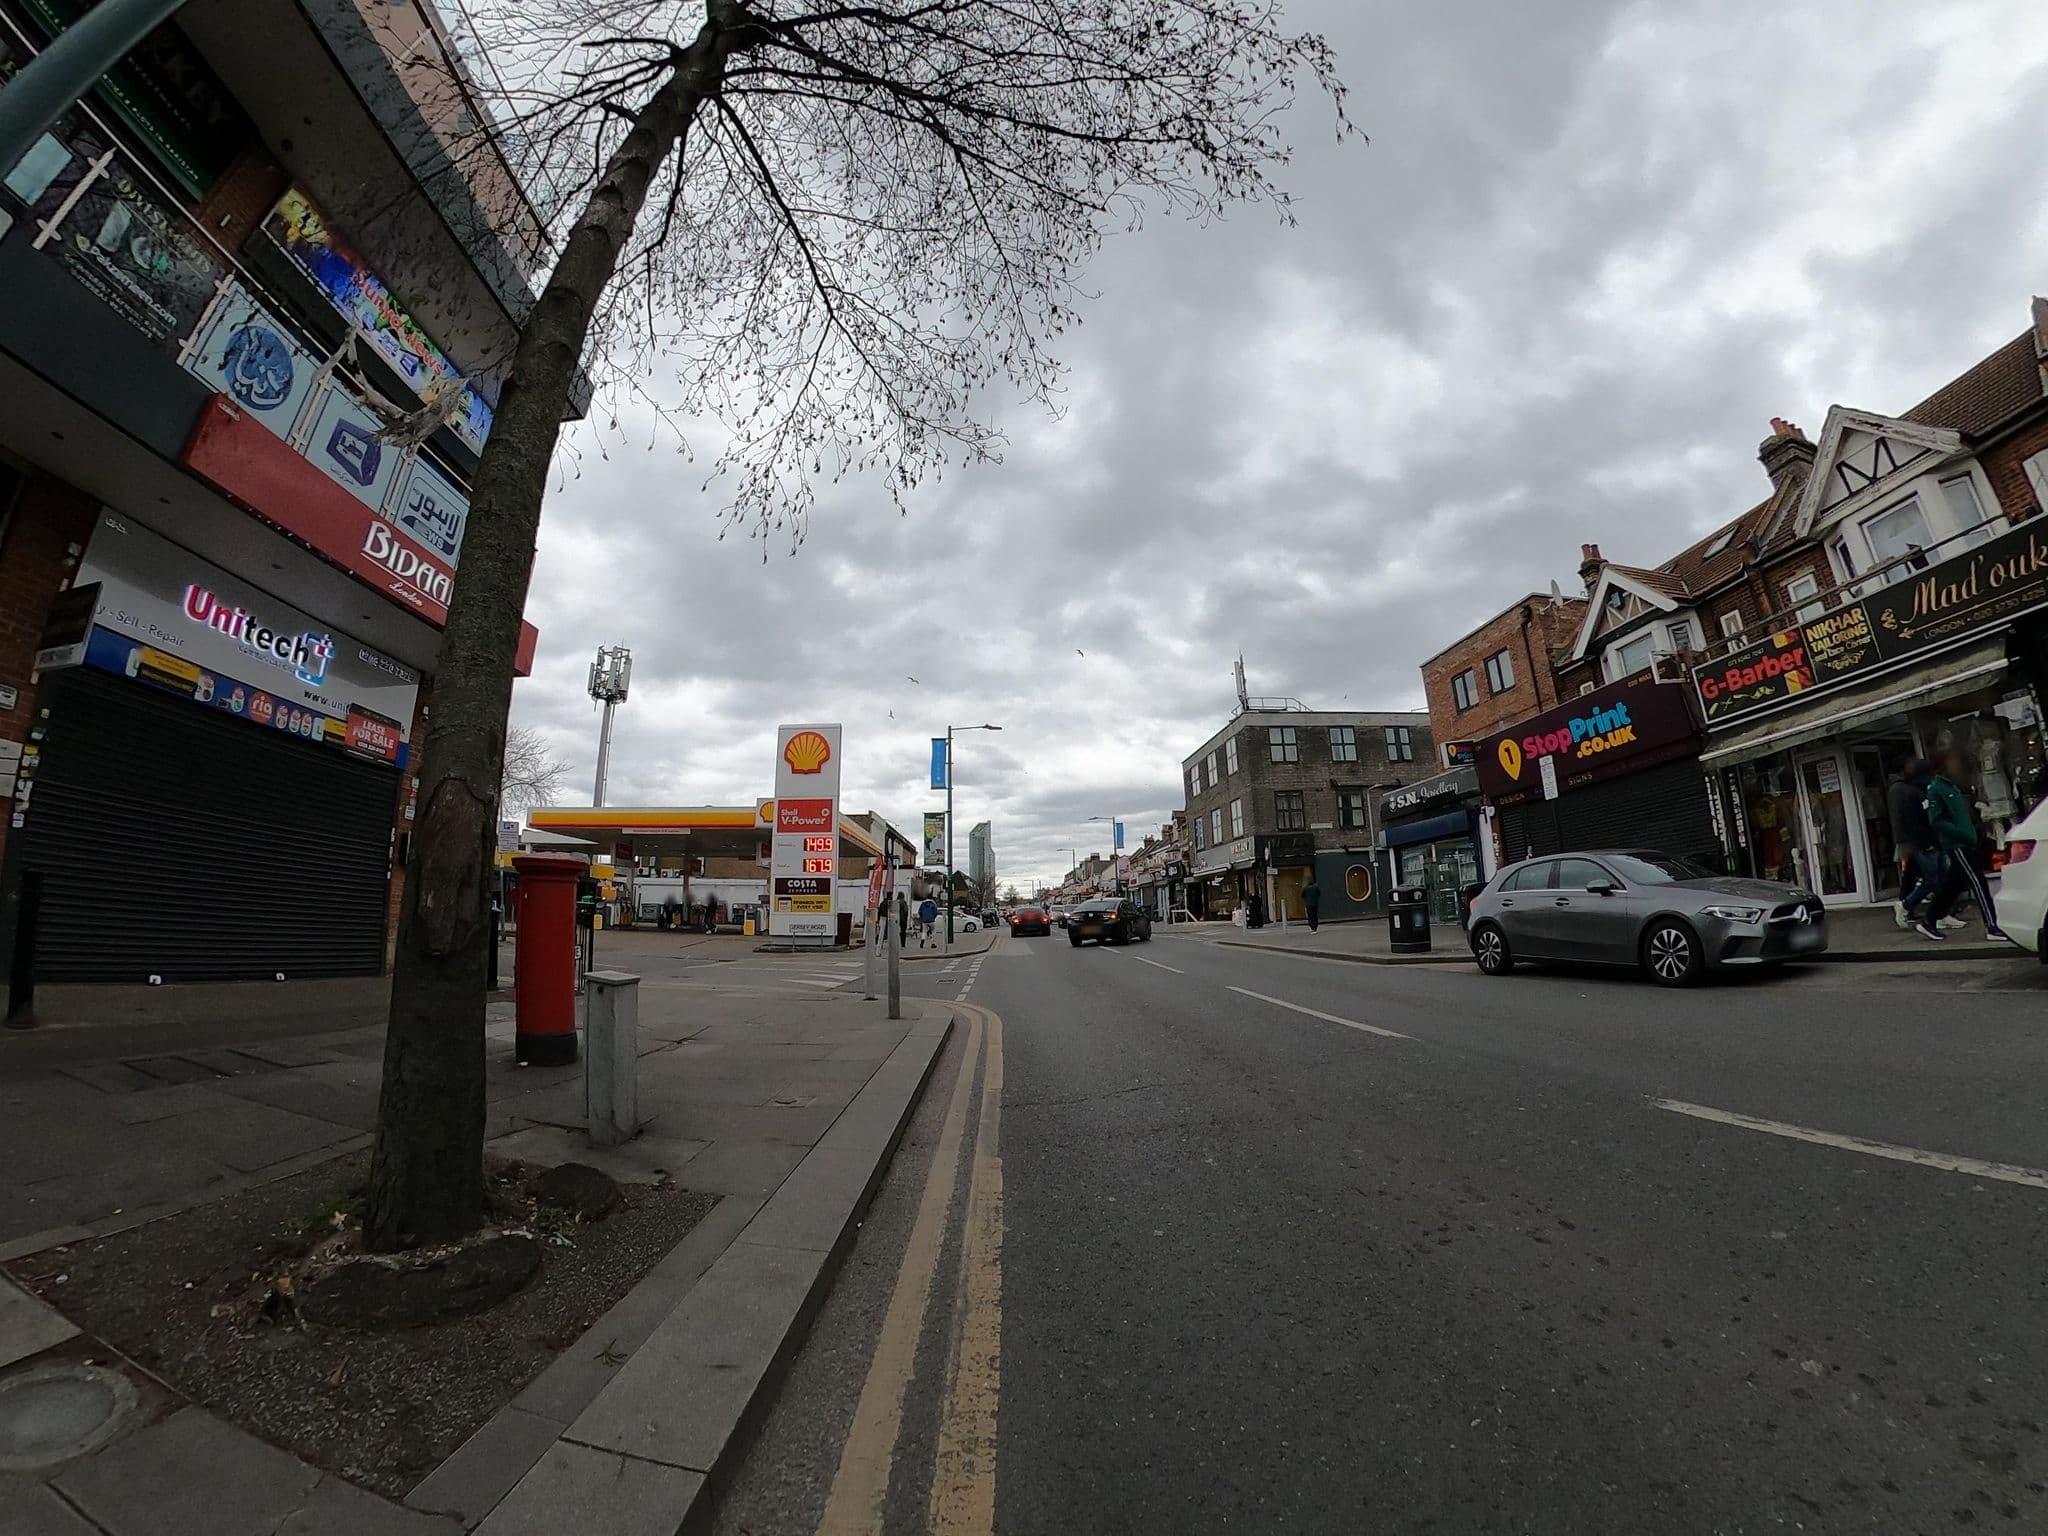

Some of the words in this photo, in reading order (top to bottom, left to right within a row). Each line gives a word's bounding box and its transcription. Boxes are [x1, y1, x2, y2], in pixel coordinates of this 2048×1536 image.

[183, 583, 310, 669] Unitech
[1806, 607, 1865, 641] NIKHAR
[1924, 619, 1966, 640] LONDON
[148, 623, 184, 647] Repair
[1810, 622, 1869, 652] TAILORING
[1701, 643, 1806, 699] G-Barber
[363, 719, 386, 735] LEASE
[352, 727, 372, 741] FOR
[374, 733, 395, 749] SALE
[1576, 724, 1638, 759] .co.uk
[1567, 773, 1593, 786] SIGNS
[1397, 791, 1420, 809] S.N.
[781, 808, 798, 816] Shell
[781, 816, 827, 825] V-Power
[787, 879, 817, 888] COSTA
